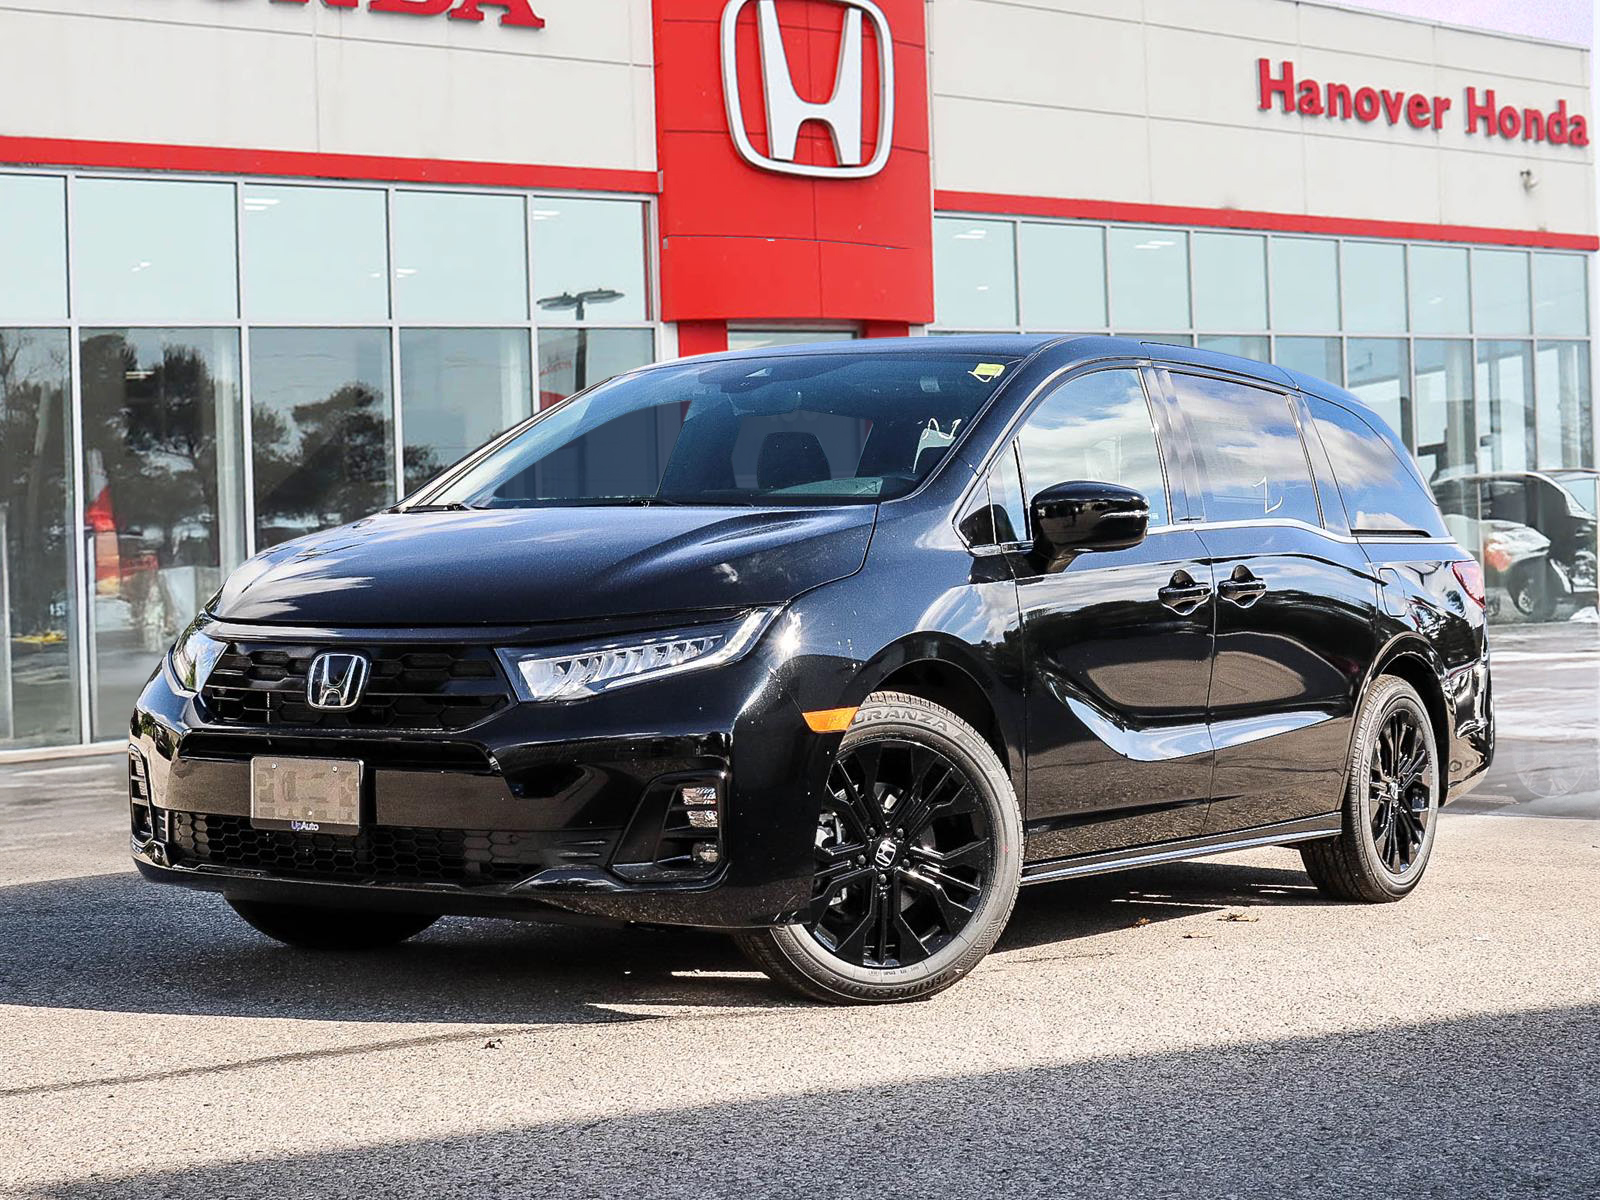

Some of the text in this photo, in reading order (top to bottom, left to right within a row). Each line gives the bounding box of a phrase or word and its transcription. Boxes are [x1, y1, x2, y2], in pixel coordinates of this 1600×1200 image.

[1257, 58, 1590, 146] Hanover Honda
[290, 820, 320, 832] UpAuto
